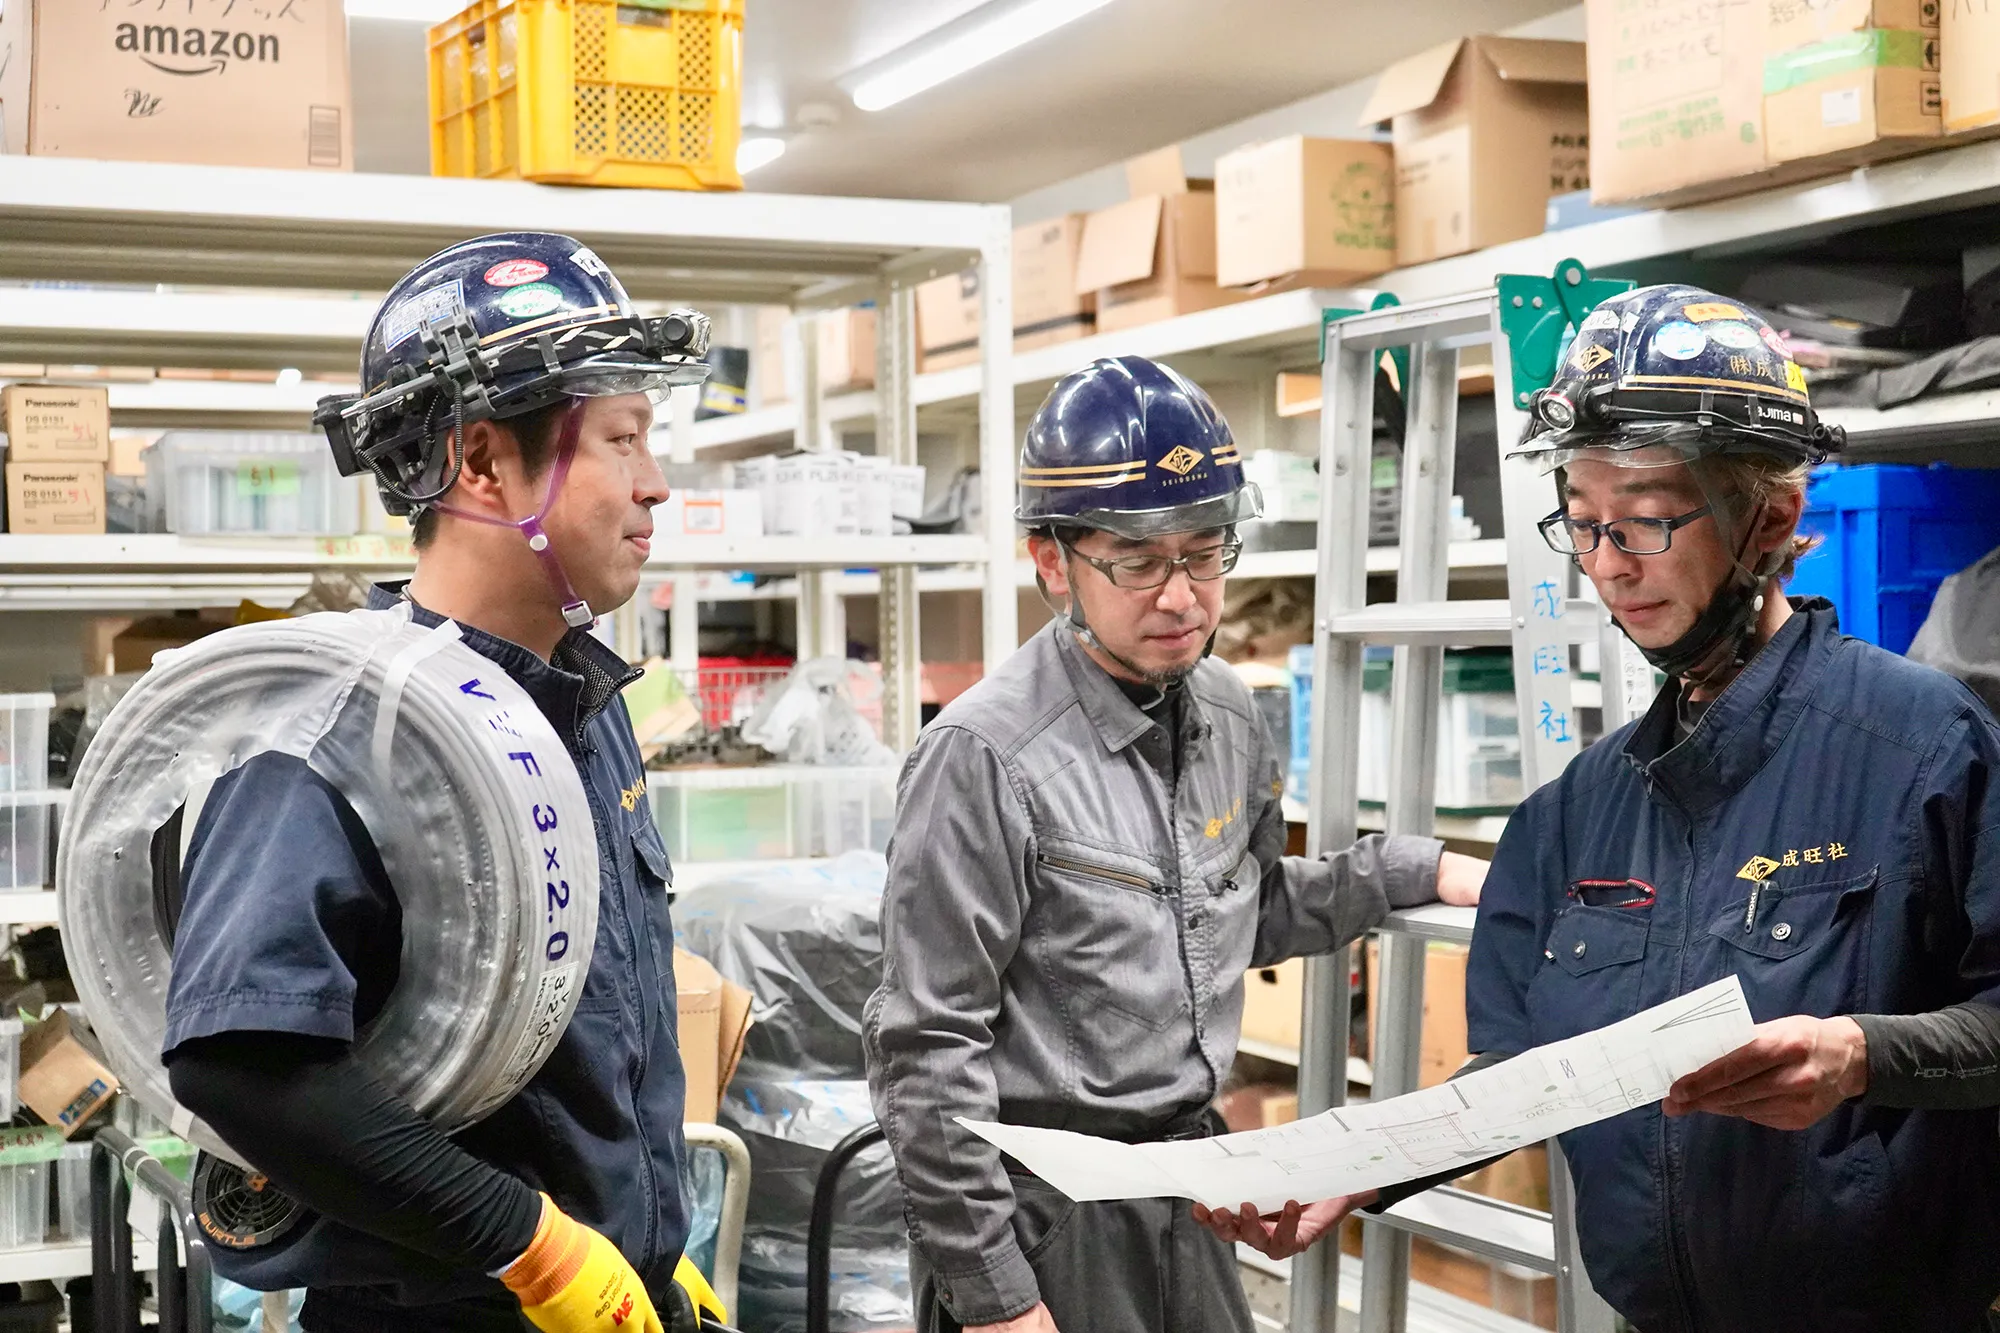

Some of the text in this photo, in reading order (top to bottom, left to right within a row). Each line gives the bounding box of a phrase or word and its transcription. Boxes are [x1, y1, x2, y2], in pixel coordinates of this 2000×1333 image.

[115, 22, 280, 62] amazon
[25, 399, 79, 408] Panasonic
[23, 474, 78, 483] Panasonic
[1531, 580, 1573, 743] 成旺社
[1782, 842, 1849, 867] 成旺社
[199, 1212, 256, 1246] BURTLE
[611, 1292, 634, 1327] 3M
